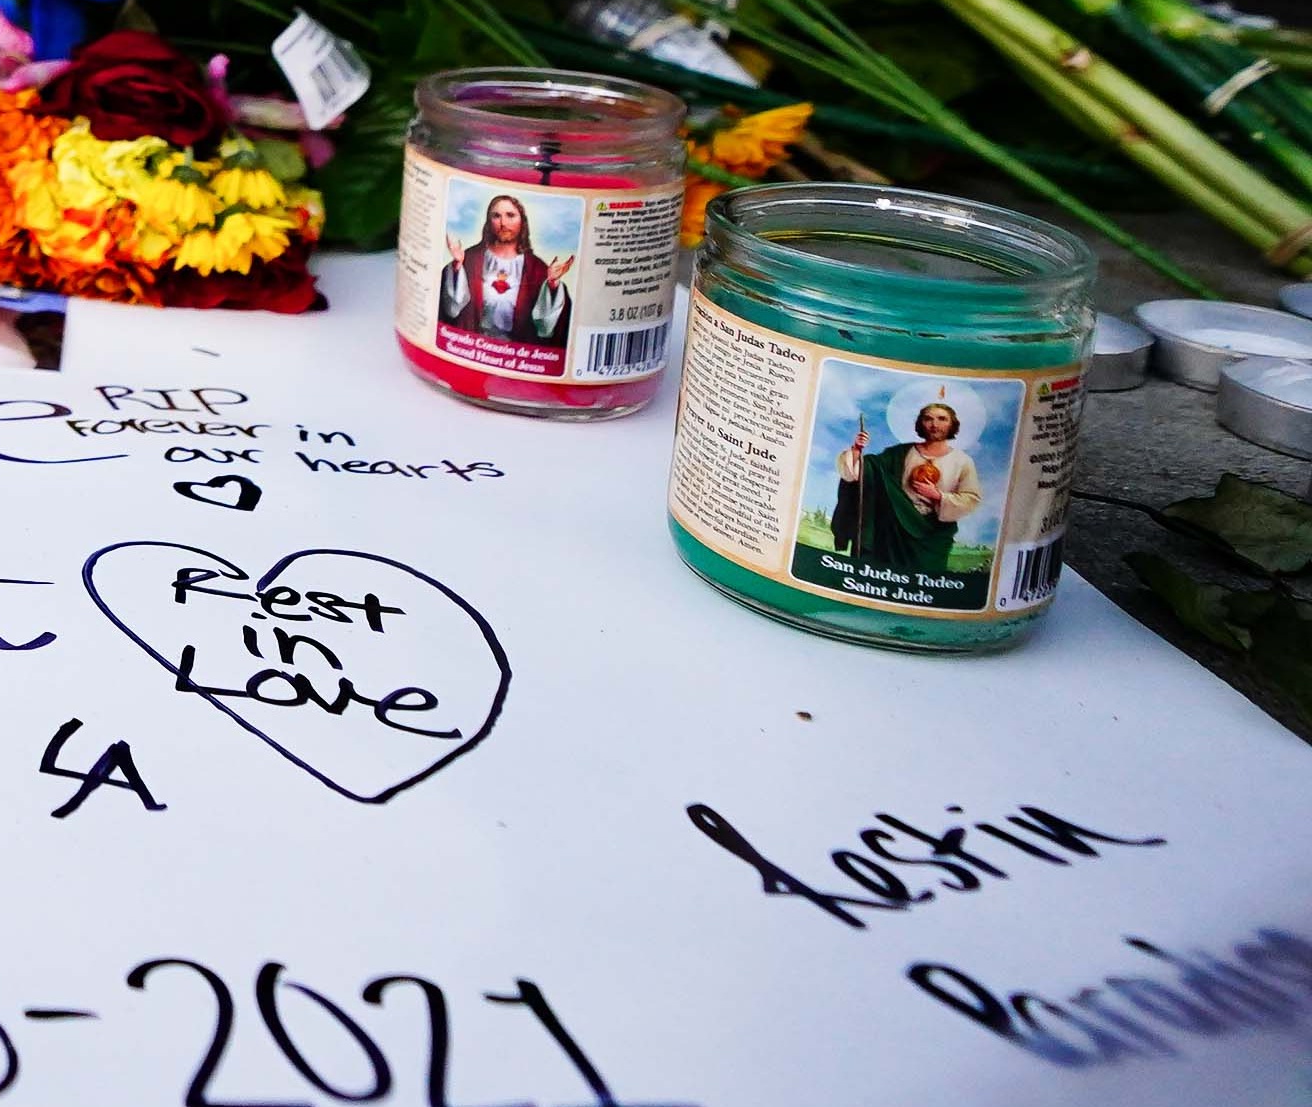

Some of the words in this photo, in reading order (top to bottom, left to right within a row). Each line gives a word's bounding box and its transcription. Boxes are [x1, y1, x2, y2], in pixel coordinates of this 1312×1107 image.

[720, 321, 734, 336] San
[736, 329, 765, 349] Judas
[768, 342, 806, 363] Tadeo
[94, 384, 249, 417] RIP
[296, 425, 357, 448] in
[707, 421, 715, 432] to
[717, 427, 743, 449] Saint
[745, 441, 777, 462] Jude
[164, 445, 264, 465] our
[295, 450, 507, 483] hearts
[820, 554, 855, 574] San
[859, 564, 910, 585] Judas
[914, 573, 965, 590] Tadeo
[842, 576, 888, 598] Saint
[891, 587, 934, 604] Jude
[171, 567, 407, 633] Rest
[242, 612, 343, 671] in
[175, 644, 464, 740] Love
